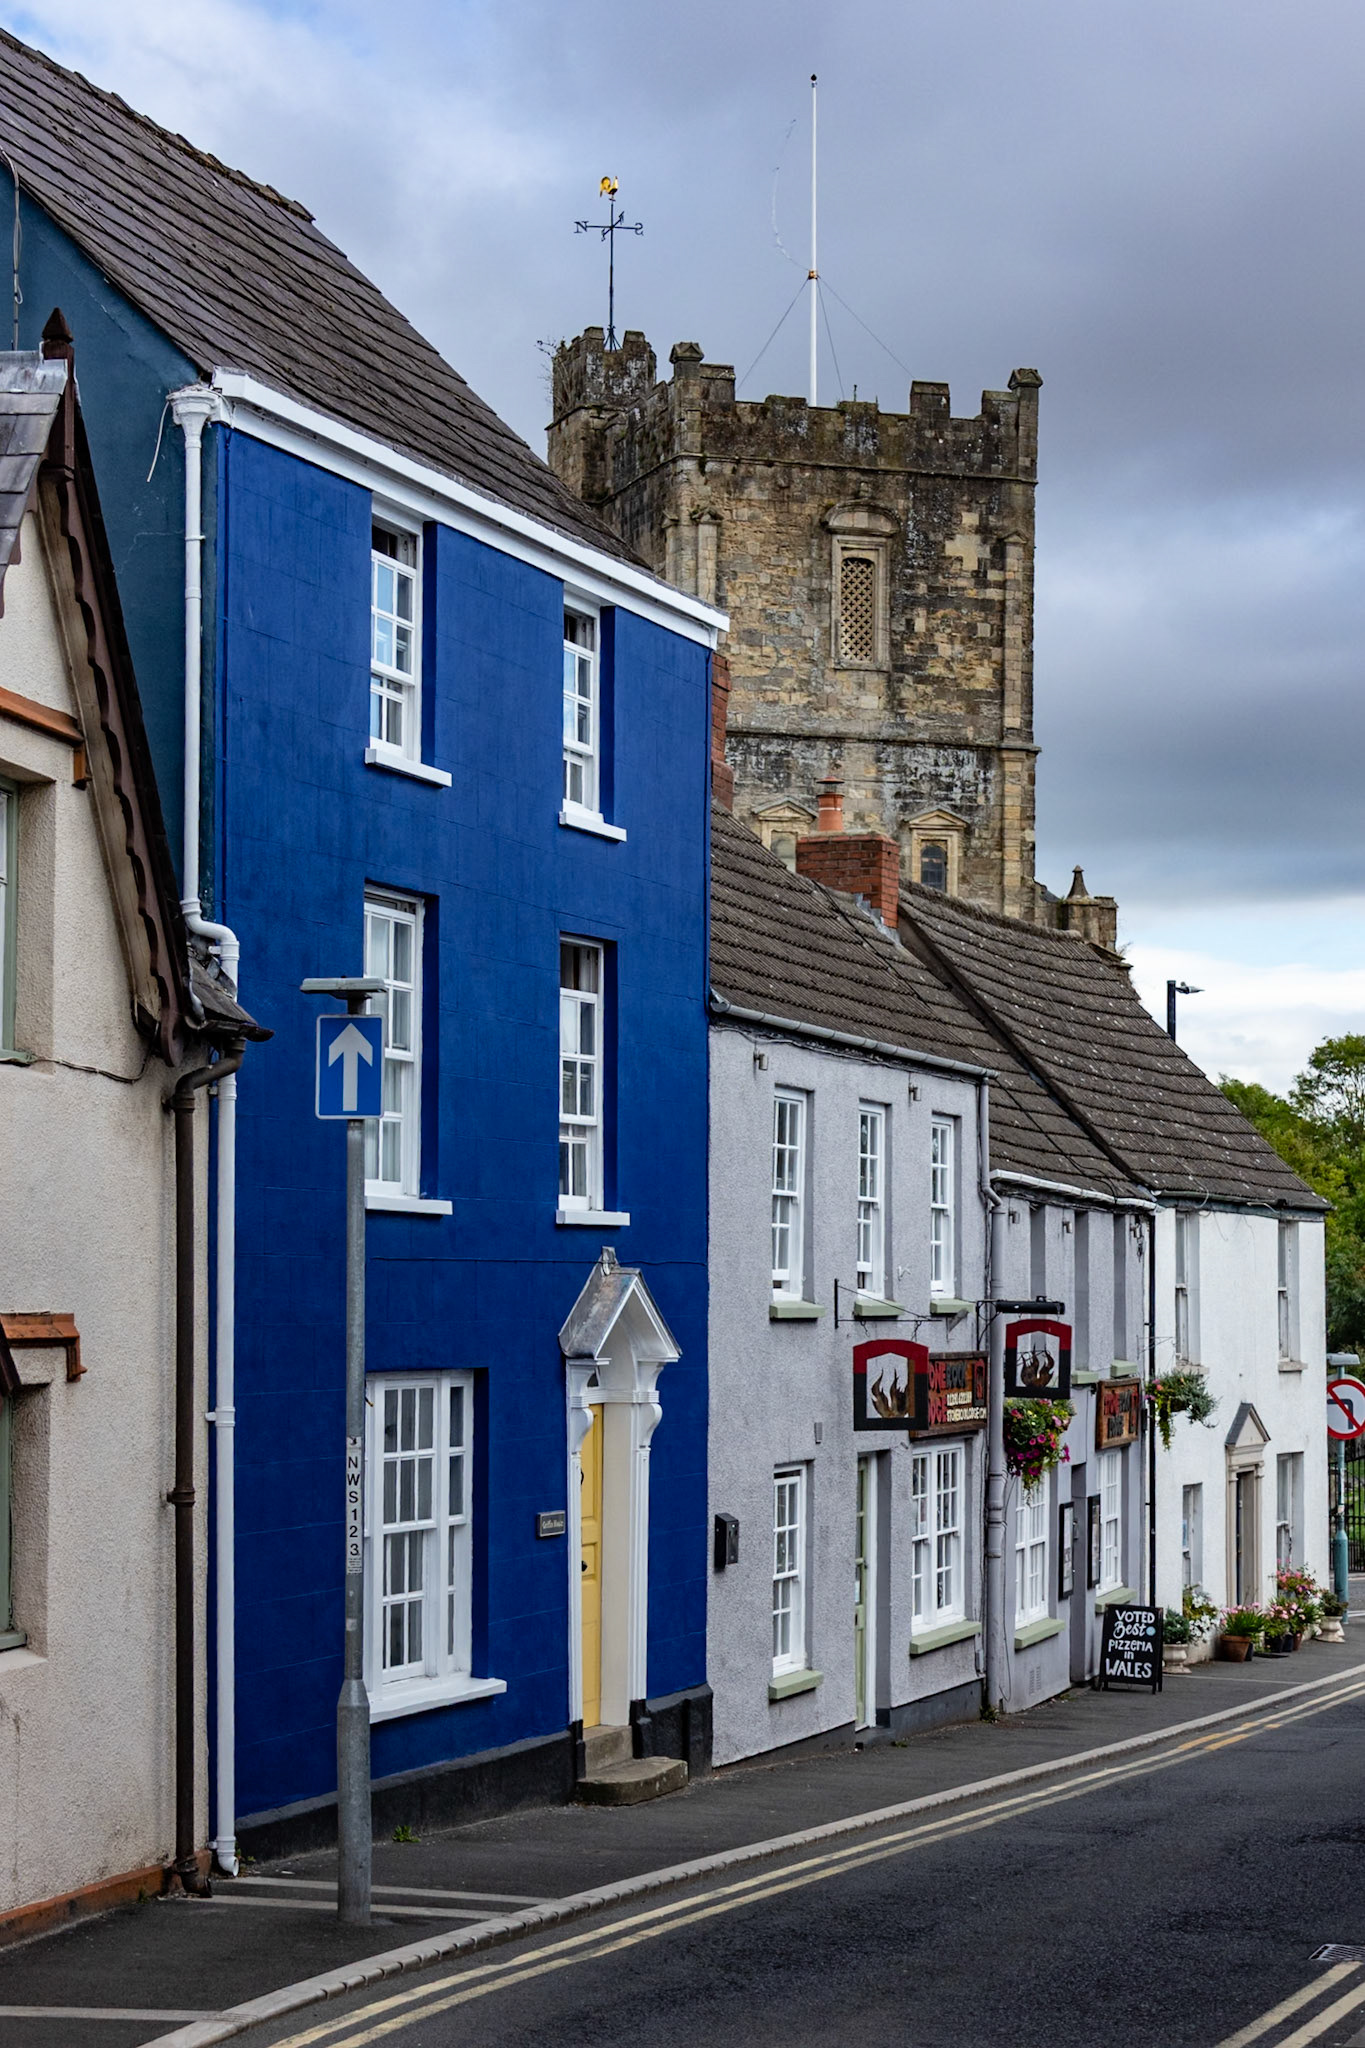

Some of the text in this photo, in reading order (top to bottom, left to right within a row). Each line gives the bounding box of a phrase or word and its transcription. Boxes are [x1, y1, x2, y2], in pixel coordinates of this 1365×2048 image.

[1115, 1609, 1155, 1624] VOTED
[1113, 1620, 1146, 1639] Best
[1105, 1658, 1152, 1678] WALES
